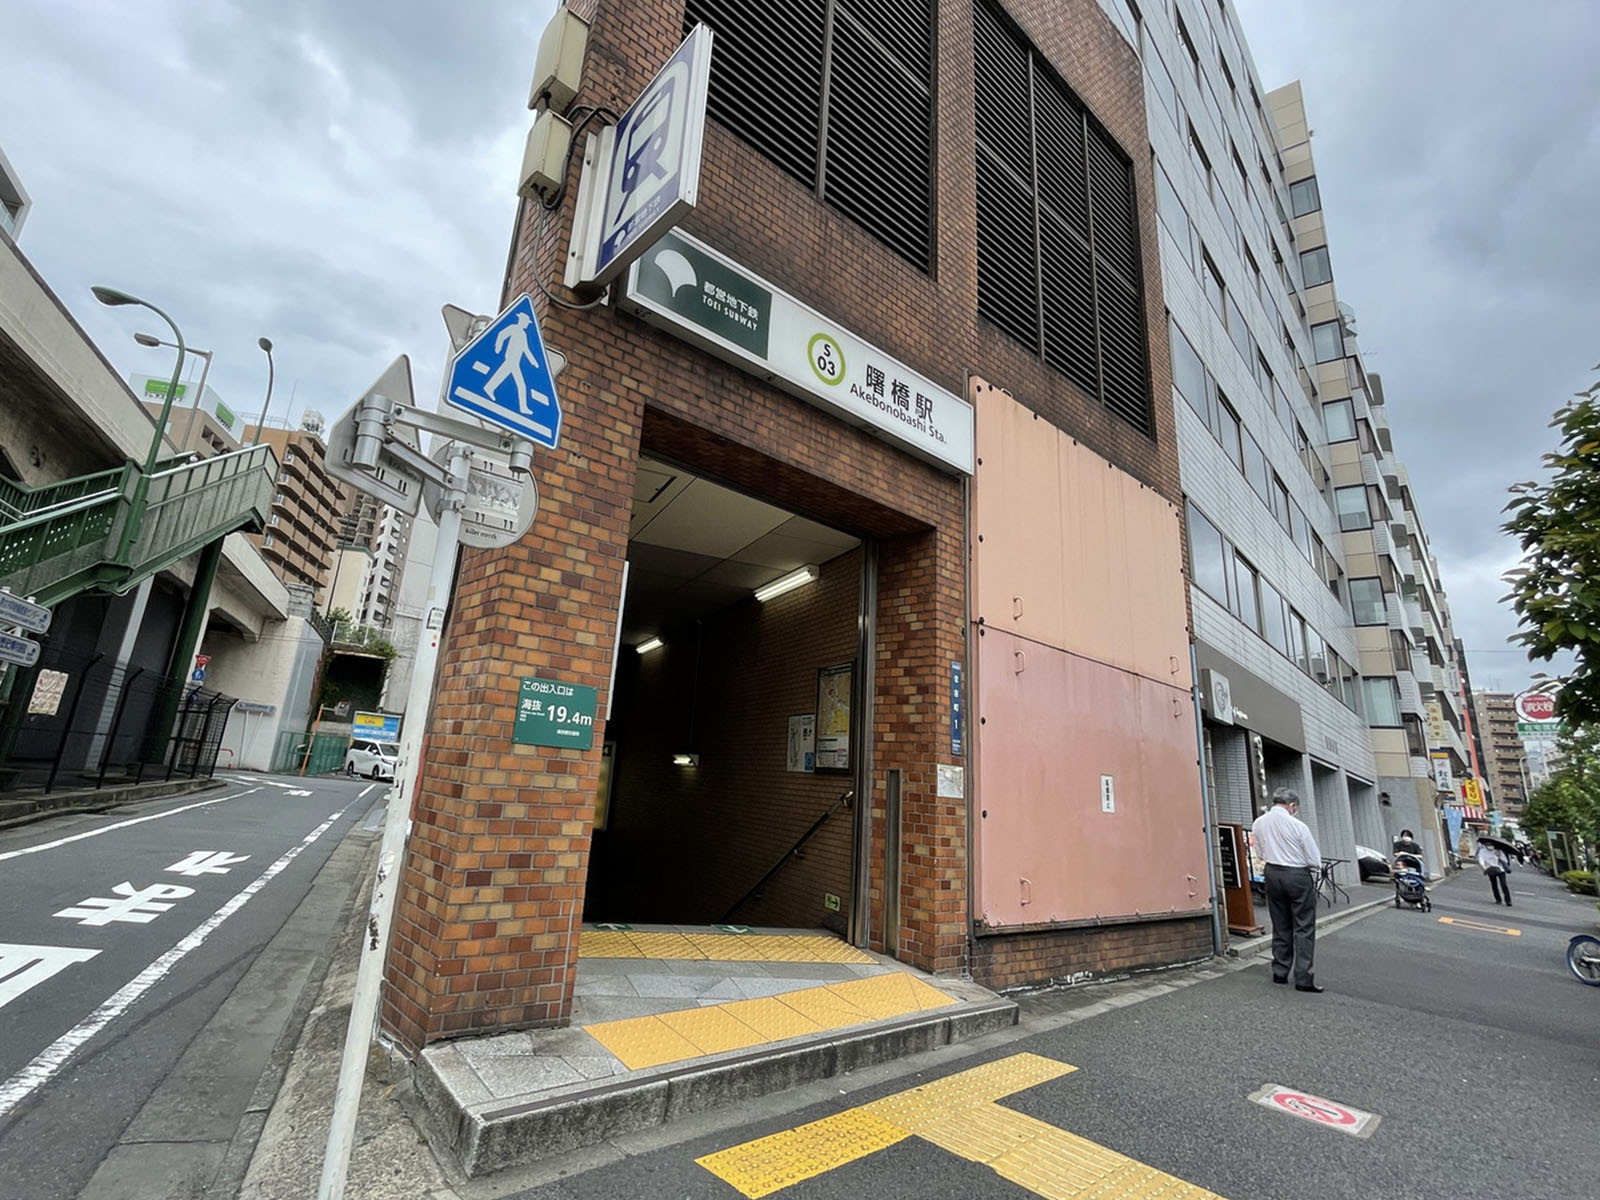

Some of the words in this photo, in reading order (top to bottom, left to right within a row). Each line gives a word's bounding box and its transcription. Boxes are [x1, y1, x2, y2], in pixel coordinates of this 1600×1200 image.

[704, 280, 759, 321] 都営地下鉄
[702, 294, 722, 312] TOEI
[724, 307, 757, 332] SUBWAY
[823, 343, 831, 358] S
[817, 355, 836, 377] 03
[865, 363, 934, 424] 曙橋駅
[850, 383, 927, 433] Akebonobashi
[928, 425, 948, 445] Sta.
[522, 680, 575, 697] この出入口は
[521, 697, 543, 712] 海抜
[547, 704, 593, 726] 19.4m
